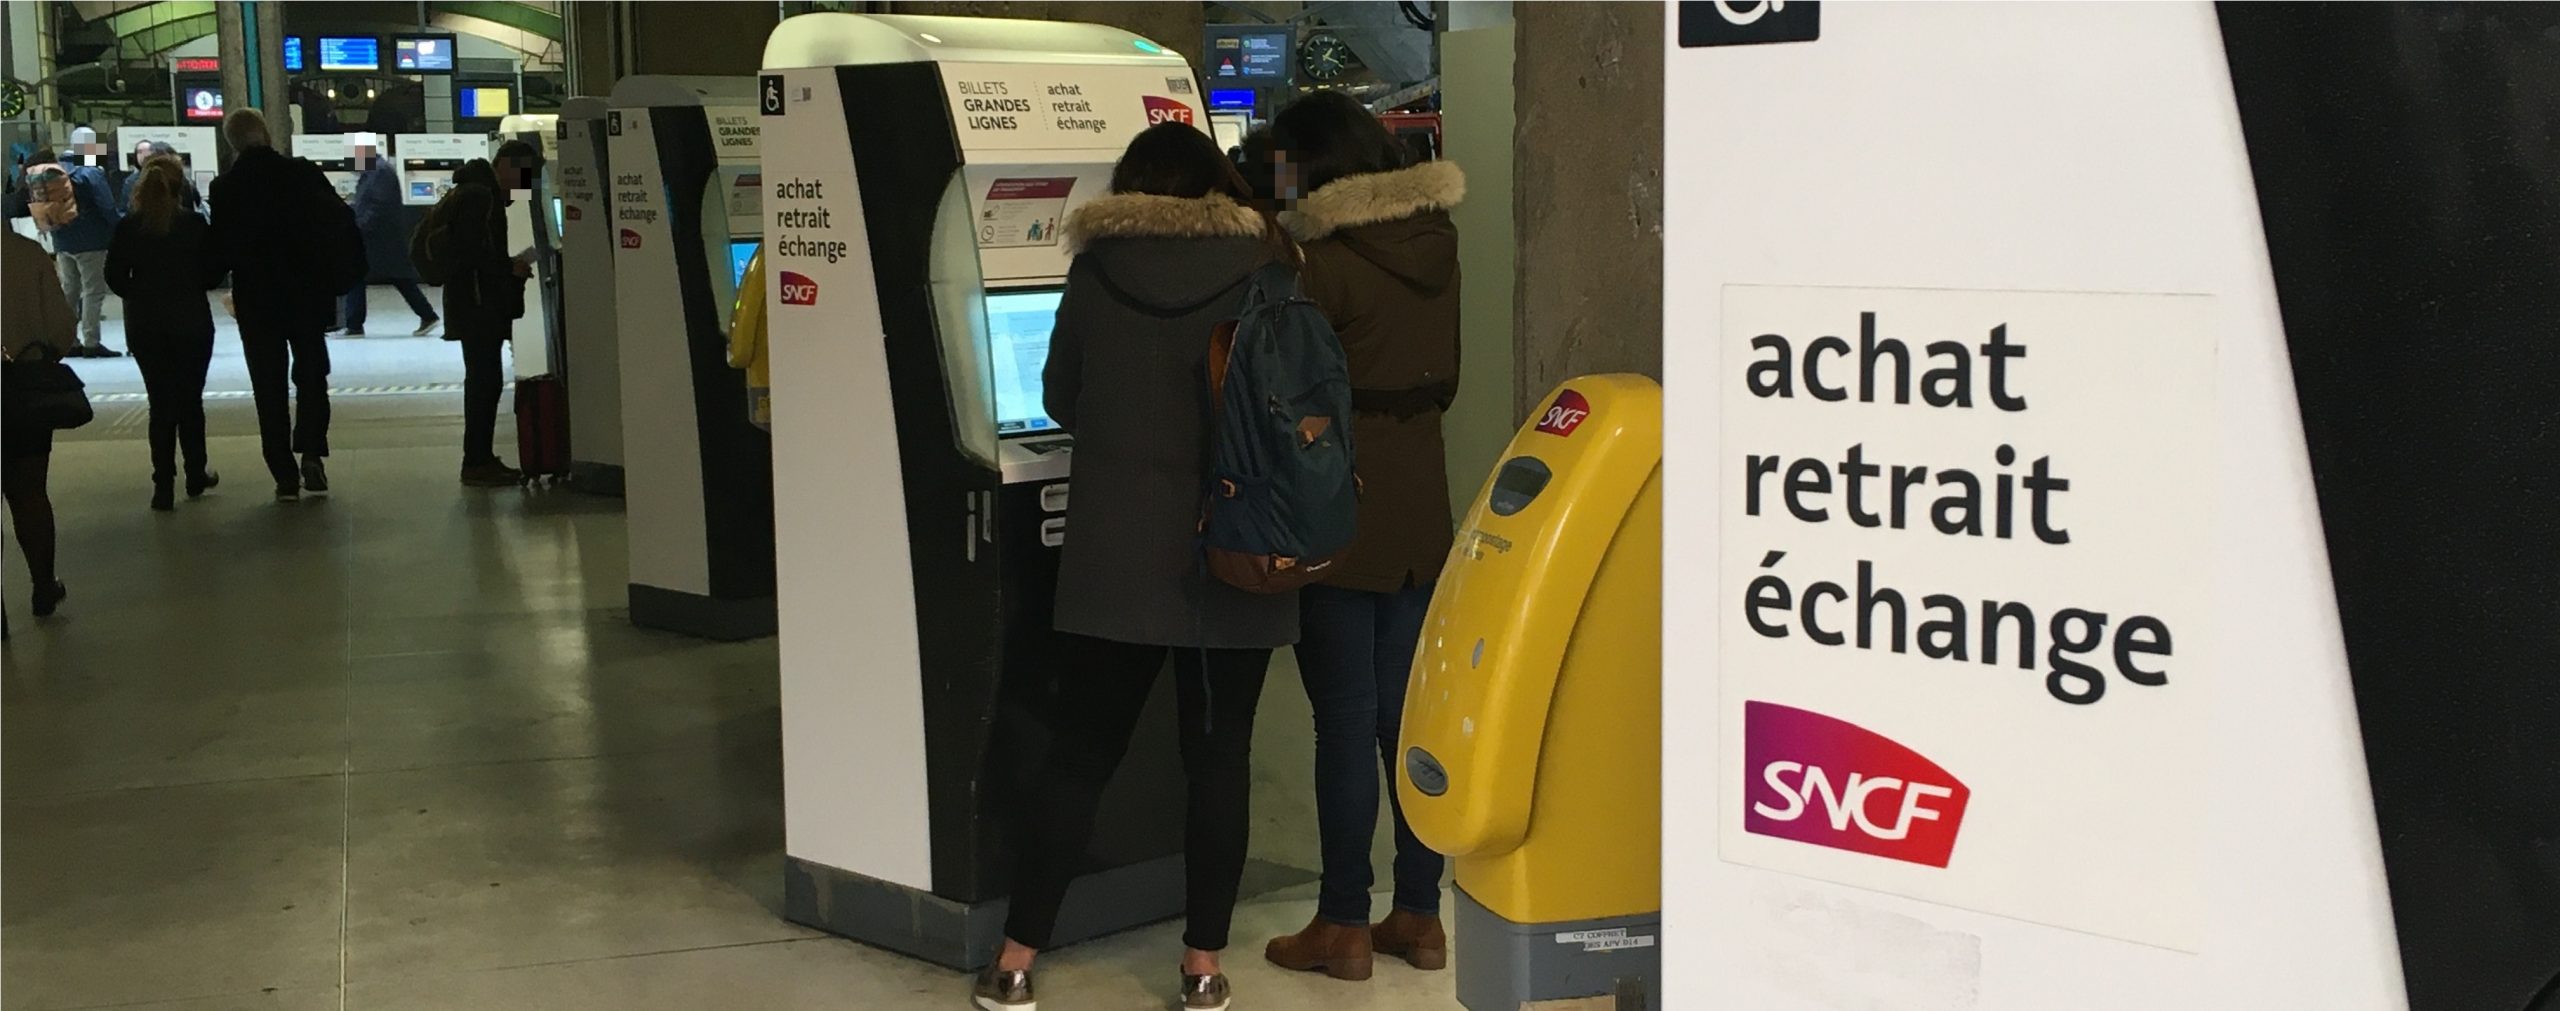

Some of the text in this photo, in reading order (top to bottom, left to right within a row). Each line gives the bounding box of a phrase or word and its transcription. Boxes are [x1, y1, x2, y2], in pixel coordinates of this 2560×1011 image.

[958, 81, 1008, 95] BILLETS
[1047, 83, 1082, 96] achat
[963, 98, 1031, 112] GRANDES
[1052, 100, 1092, 113] retrait
[716, 117, 748, 125] BILLETS
[968, 116, 1018, 130] LIGNES
[1149, 108, 1190, 124] SNCF
[1056, 116, 1107, 133] échange
[722, 137, 753, 146] LIGNES
[617, 173, 643, 186] achat
[618, 190, 648, 202] retrait
[776, 177, 823, 199] achat
[619, 206, 657, 224] échange
[777, 206, 831, 229] retrait
[621, 236, 640, 247] SNCF
[778, 235, 847, 264] échange
[782, 283, 816, 301] SNCF
[1746, 311, 2028, 411] achat
[1539, 405, 1588, 430] SNCF
[1744, 443, 2071, 546] retrait
[1742, 551, 2174, 706] échange
[1753, 759, 1953, 841] SNCF
